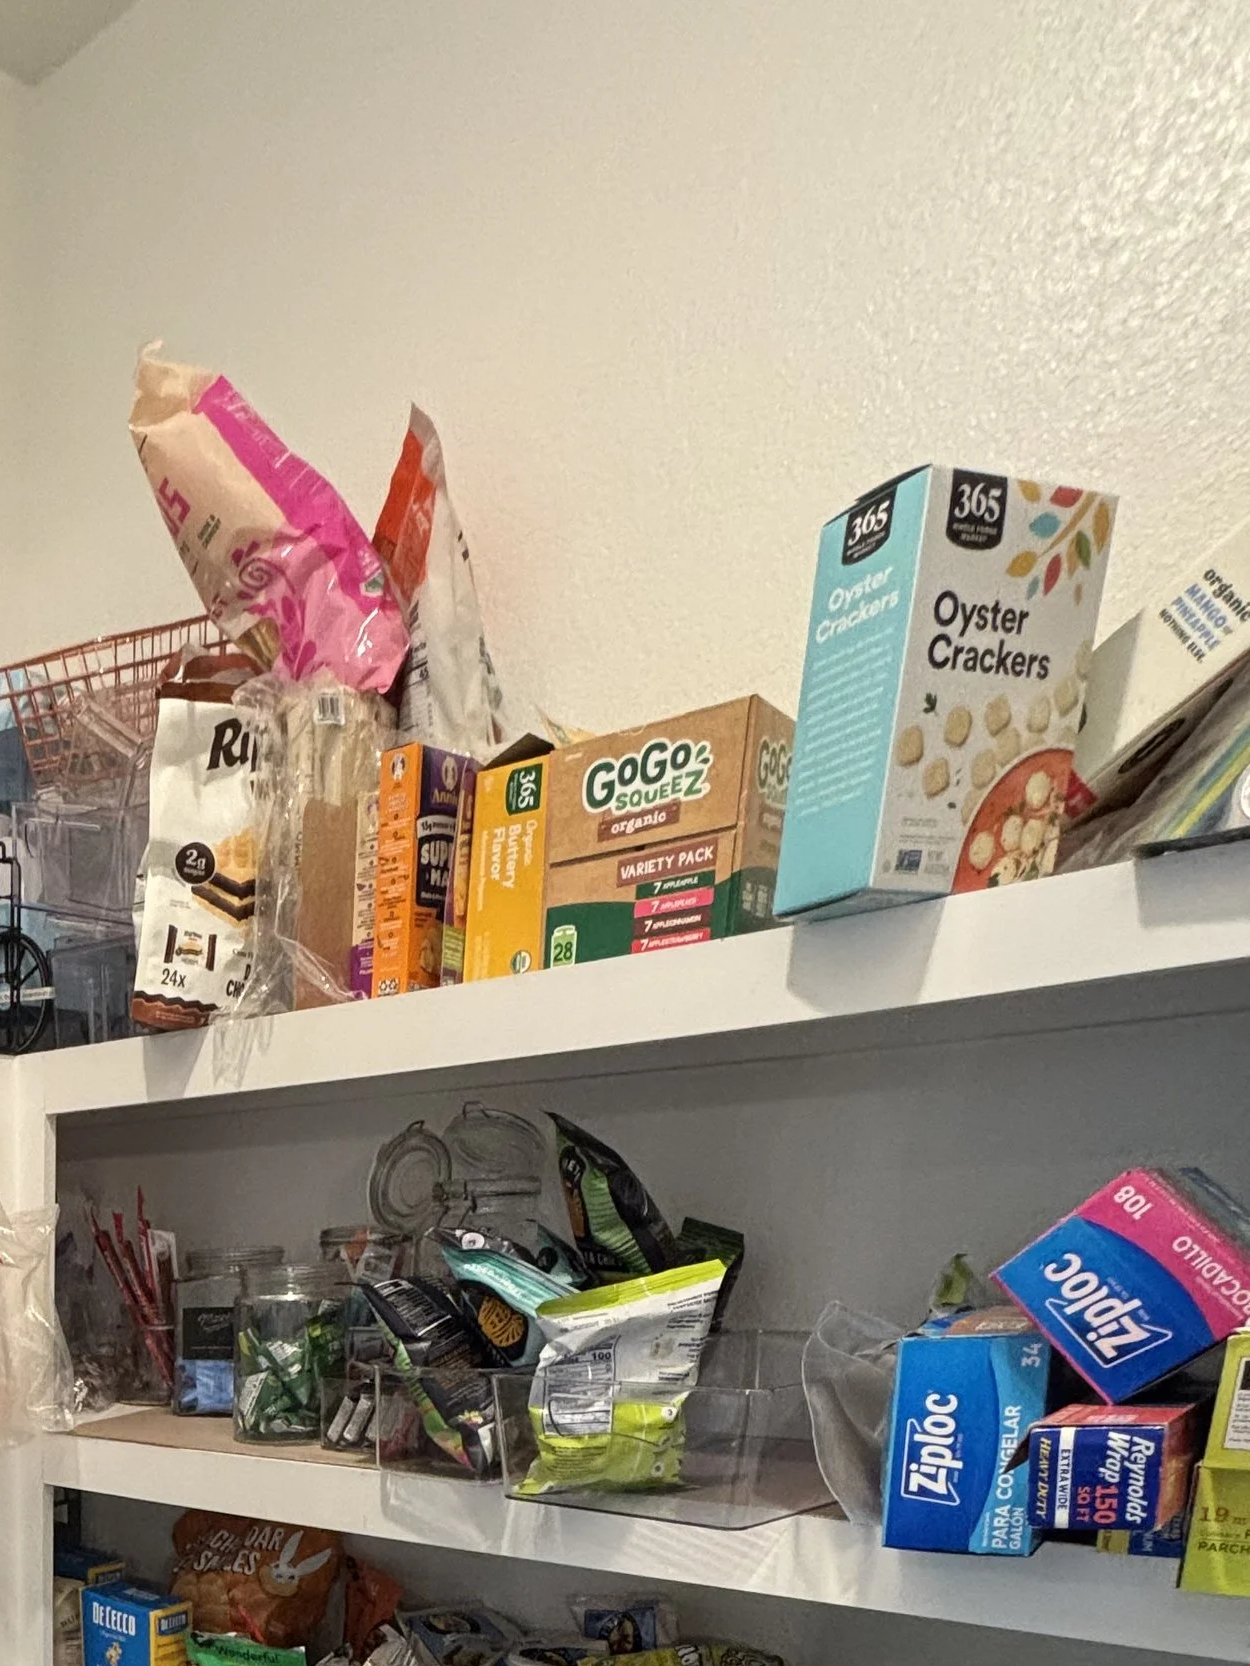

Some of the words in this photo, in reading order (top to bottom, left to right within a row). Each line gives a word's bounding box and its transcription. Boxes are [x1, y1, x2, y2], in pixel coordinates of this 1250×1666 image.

[954, 483, 1002, 523] 365
[848, 500, 889, 546] 365
[828, 566, 894, 612] Oyster
[1185, 583, 1227, 629] MANGO
[1203, 568, 1250, 623] organic
[815, 590, 900, 644] Crackers
[934, 590, 1029, 637] Oyster
[1159, 608, 1191, 647] NOTHING
[1171, 596, 1222, 652] PINEAPPLE
[928, 633, 1050, 680] Crackers
[518, 771, 535, 808] 365
[586, 741, 692, 811] GoGo
[611, 811, 667, 834] organic
[186, 849, 206, 871] 2g
[491, 828, 502, 881] Flavor
[503, 824, 522, 888] Buttery
[620, 853, 675, 880] VARIETY
[678, 846, 714, 866] PACK
[651, 900, 660, 912] 7
[653, 882, 661, 893] 7
[644, 920, 652, 932] 7
[554, 941, 573, 962] 28
[161, 967, 187, 988] 24x
[1113, 1185, 1154, 1221] 108
[1043, 1252, 1151, 1359] Ziploc
[592, 1352, 612, 1361] 100
[1021, 1343, 1042, 1368] 34
[909, 1392, 963, 1495] Ziploc
[1039, 1437, 1051, 1478] HEAVY
[1099, 1432, 1131, 1482] Wrap
[1059, 1449, 1071, 1480] EXTRA
[1126, 1436, 1155, 1524] Reynolds
[1036, 1479, 1049, 1520] DUTY
[1058, 1481, 1070, 1510] WIDE
[1076, 1508, 1090, 1522] FT
[1077, 1487, 1091, 1505] SQ
[1093, 1486, 1119, 1525] 150
[992, 1504, 1011, 1549] PARA
[1010, 1507, 1024, 1549] GALÓN
[92, 1602, 104, 1625] DE
[105, 1609, 136, 1636] CECCO
[218, 1645, 280, 1664] Wonderful
